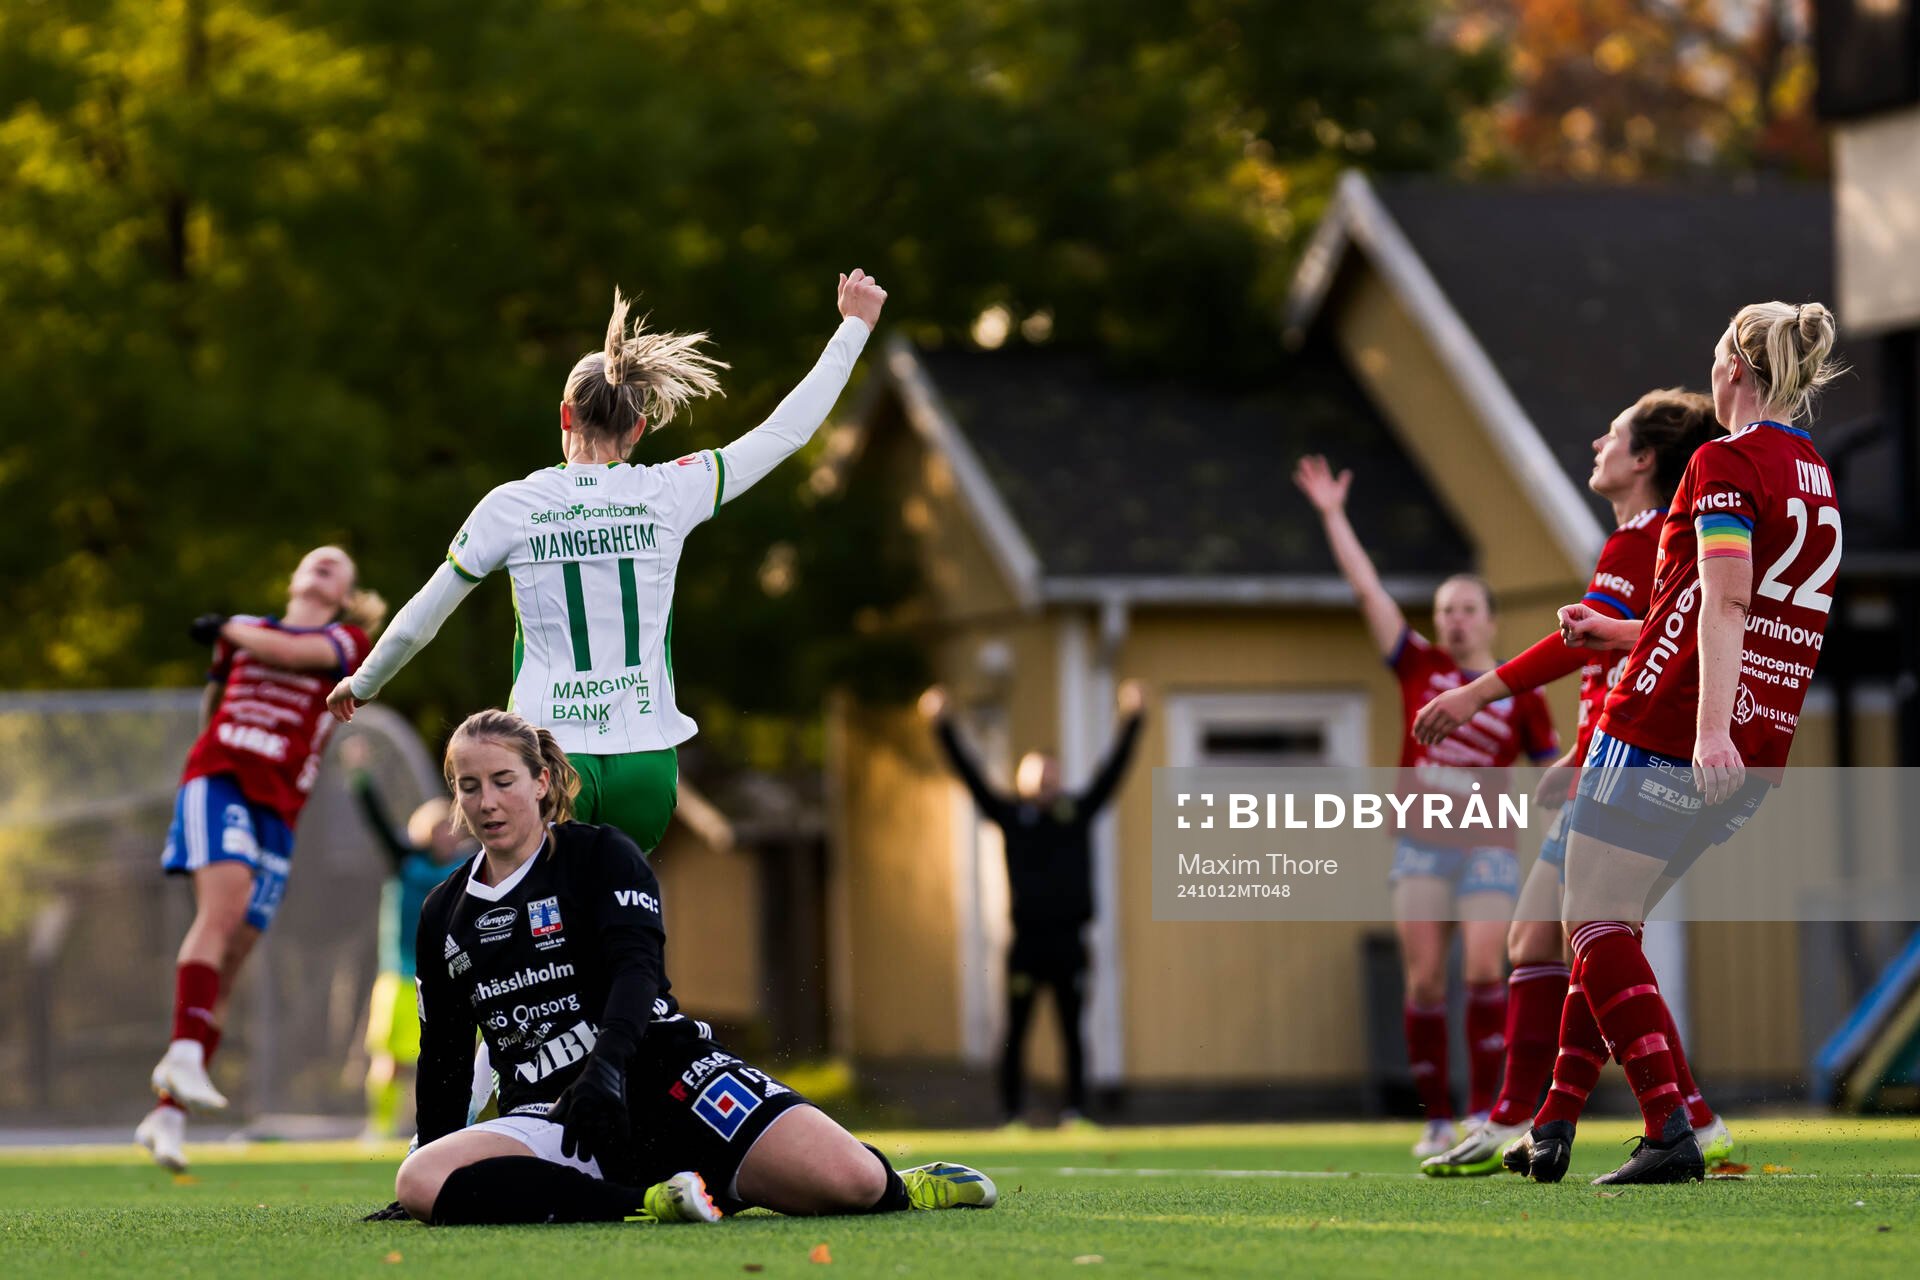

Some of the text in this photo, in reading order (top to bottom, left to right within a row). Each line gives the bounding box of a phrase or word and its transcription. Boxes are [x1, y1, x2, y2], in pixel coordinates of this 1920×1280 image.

[1796, 459, 1832, 498] LYNN
[531, 503, 648, 525] Sefina pantbank
[529, 522, 657, 562] WANGERHEIM
[1757, 497, 1843, 614] 22
[562, 557, 641, 672] 11
[1744, 612, 1824, 652] urninova
[1741, 648, 1815, 680] otorcentru
[1781, 676, 1800, 690] AB
[552, 703, 611, 721] BANK
[614, 889, 660, 915] VICI:
